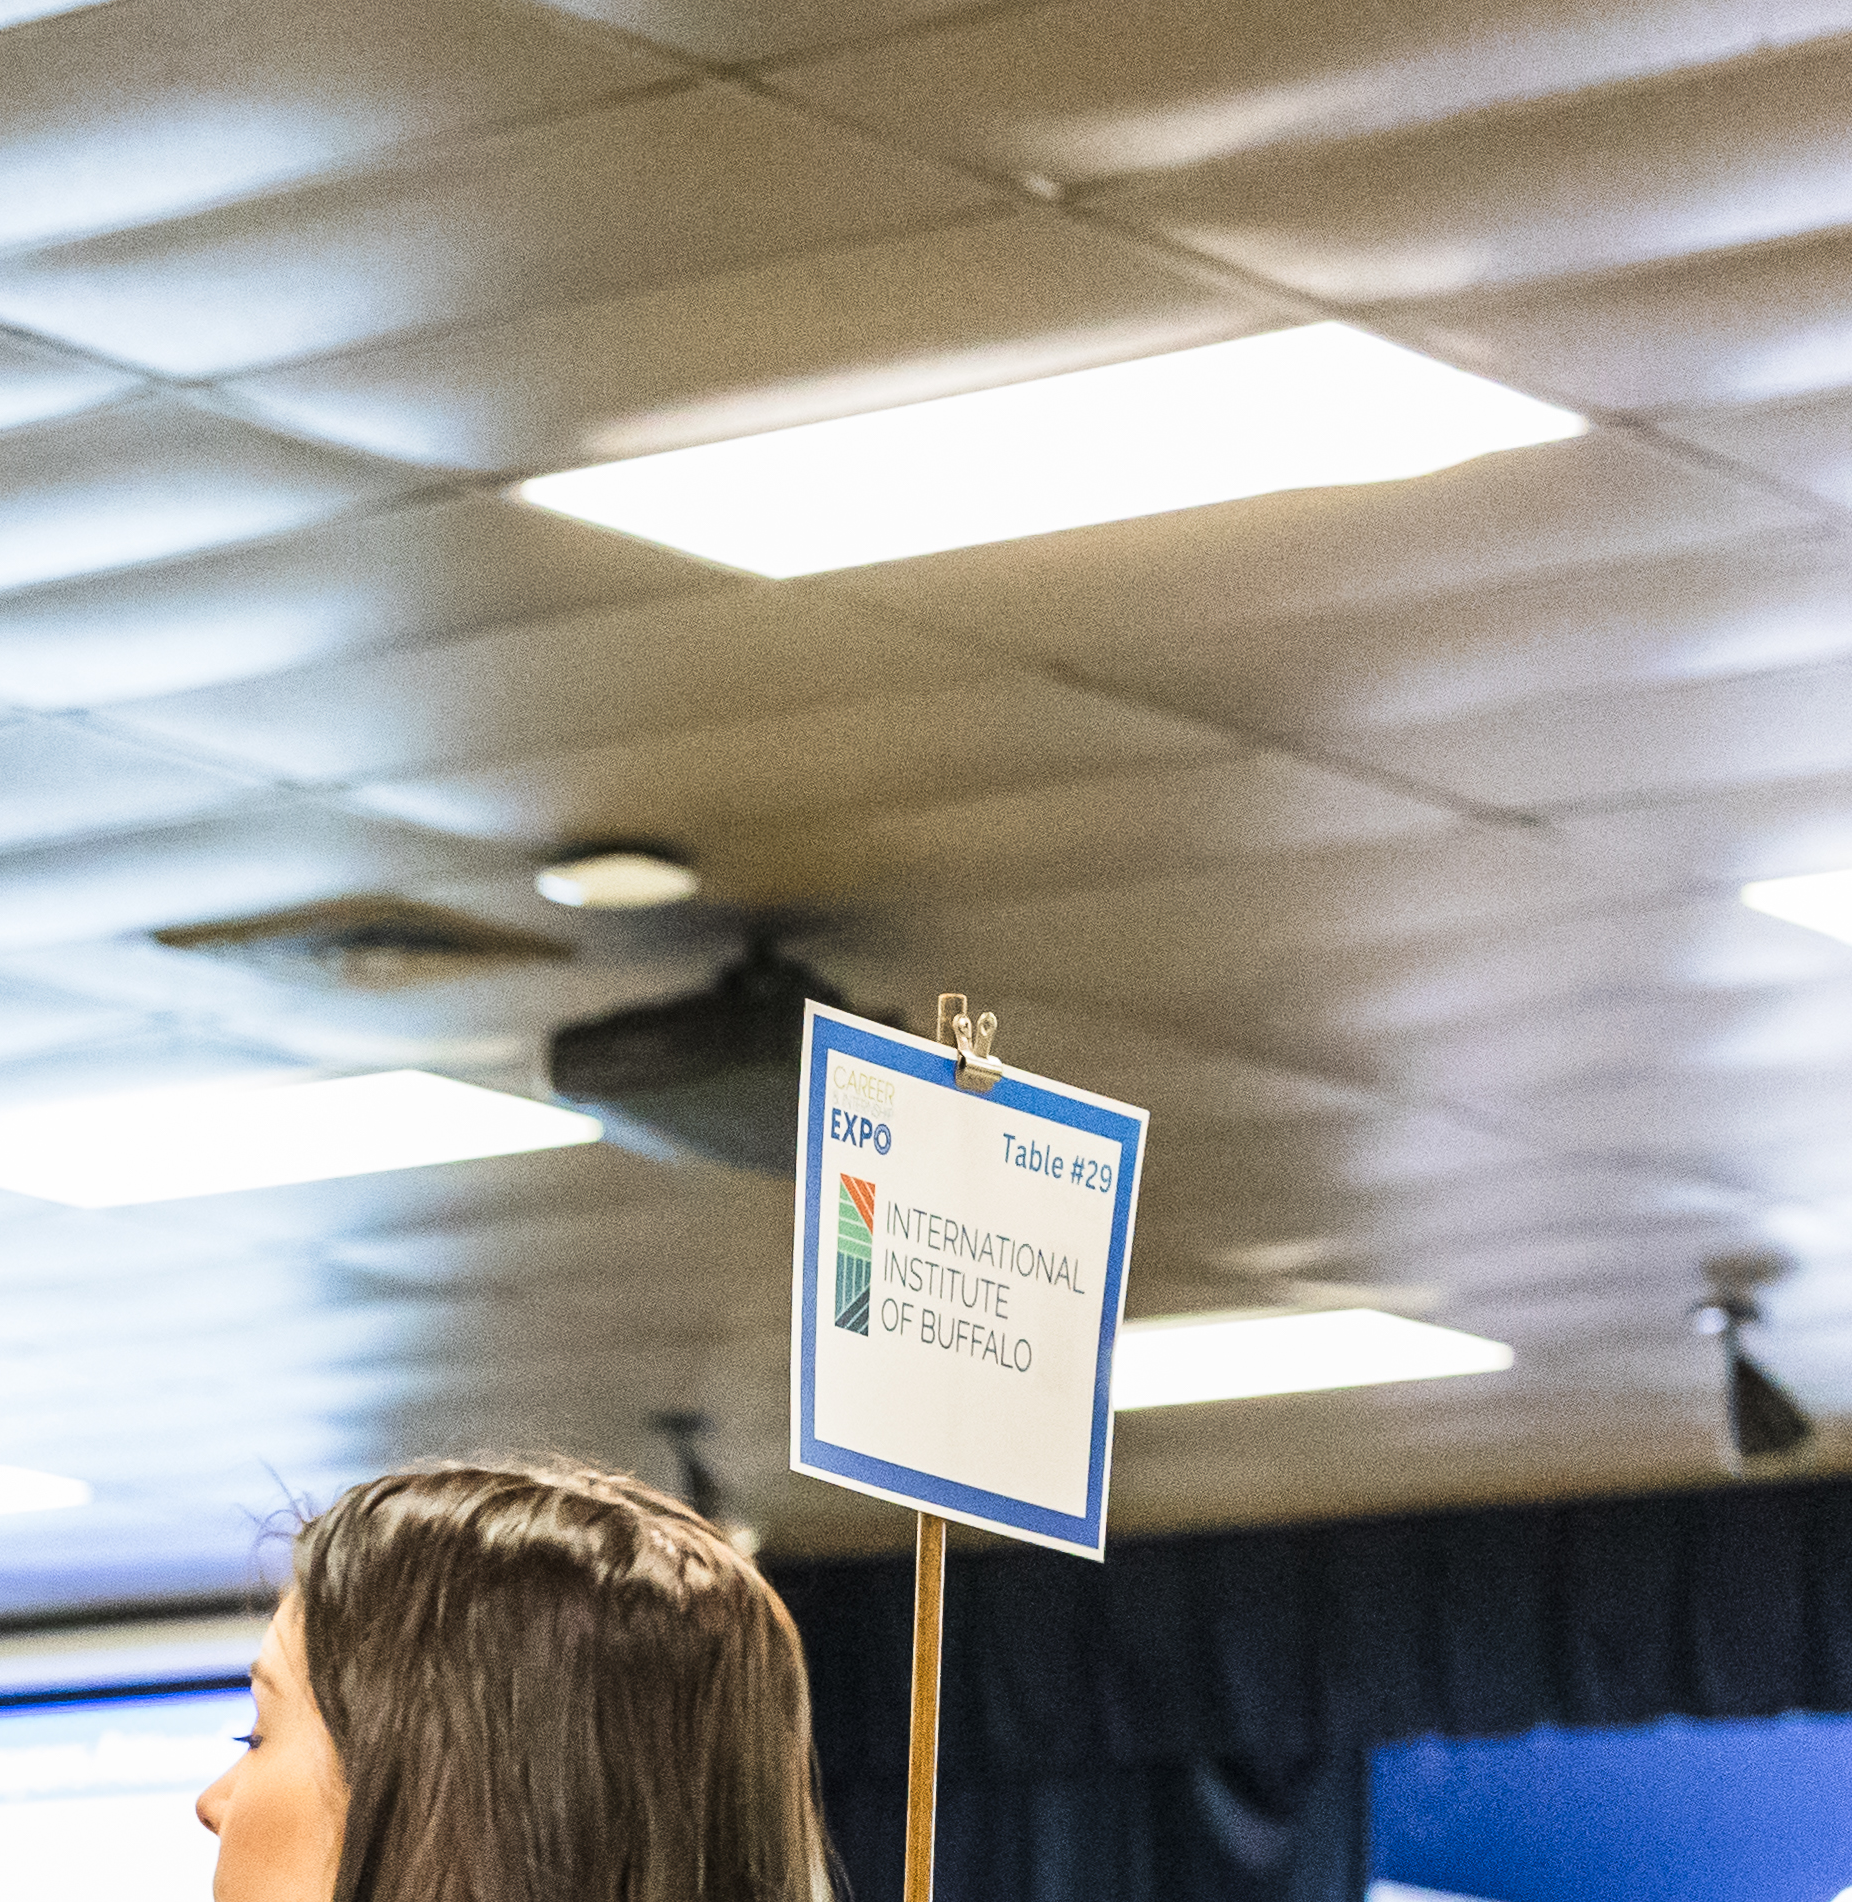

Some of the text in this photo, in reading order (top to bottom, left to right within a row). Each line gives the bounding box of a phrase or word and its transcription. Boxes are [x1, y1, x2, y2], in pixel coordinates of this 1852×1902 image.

[833, 1065, 895, 1105] CAREER
[831, 1107, 892, 1156] EXPO
[1003, 1133, 1113, 1193] Table #29
[887, 1201, 1085, 1294] INTERNATIONAL
[884, 1248, 1010, 1320] INSTITUTE
[881, 1298, 1032, 1372] OF BUFFALO
